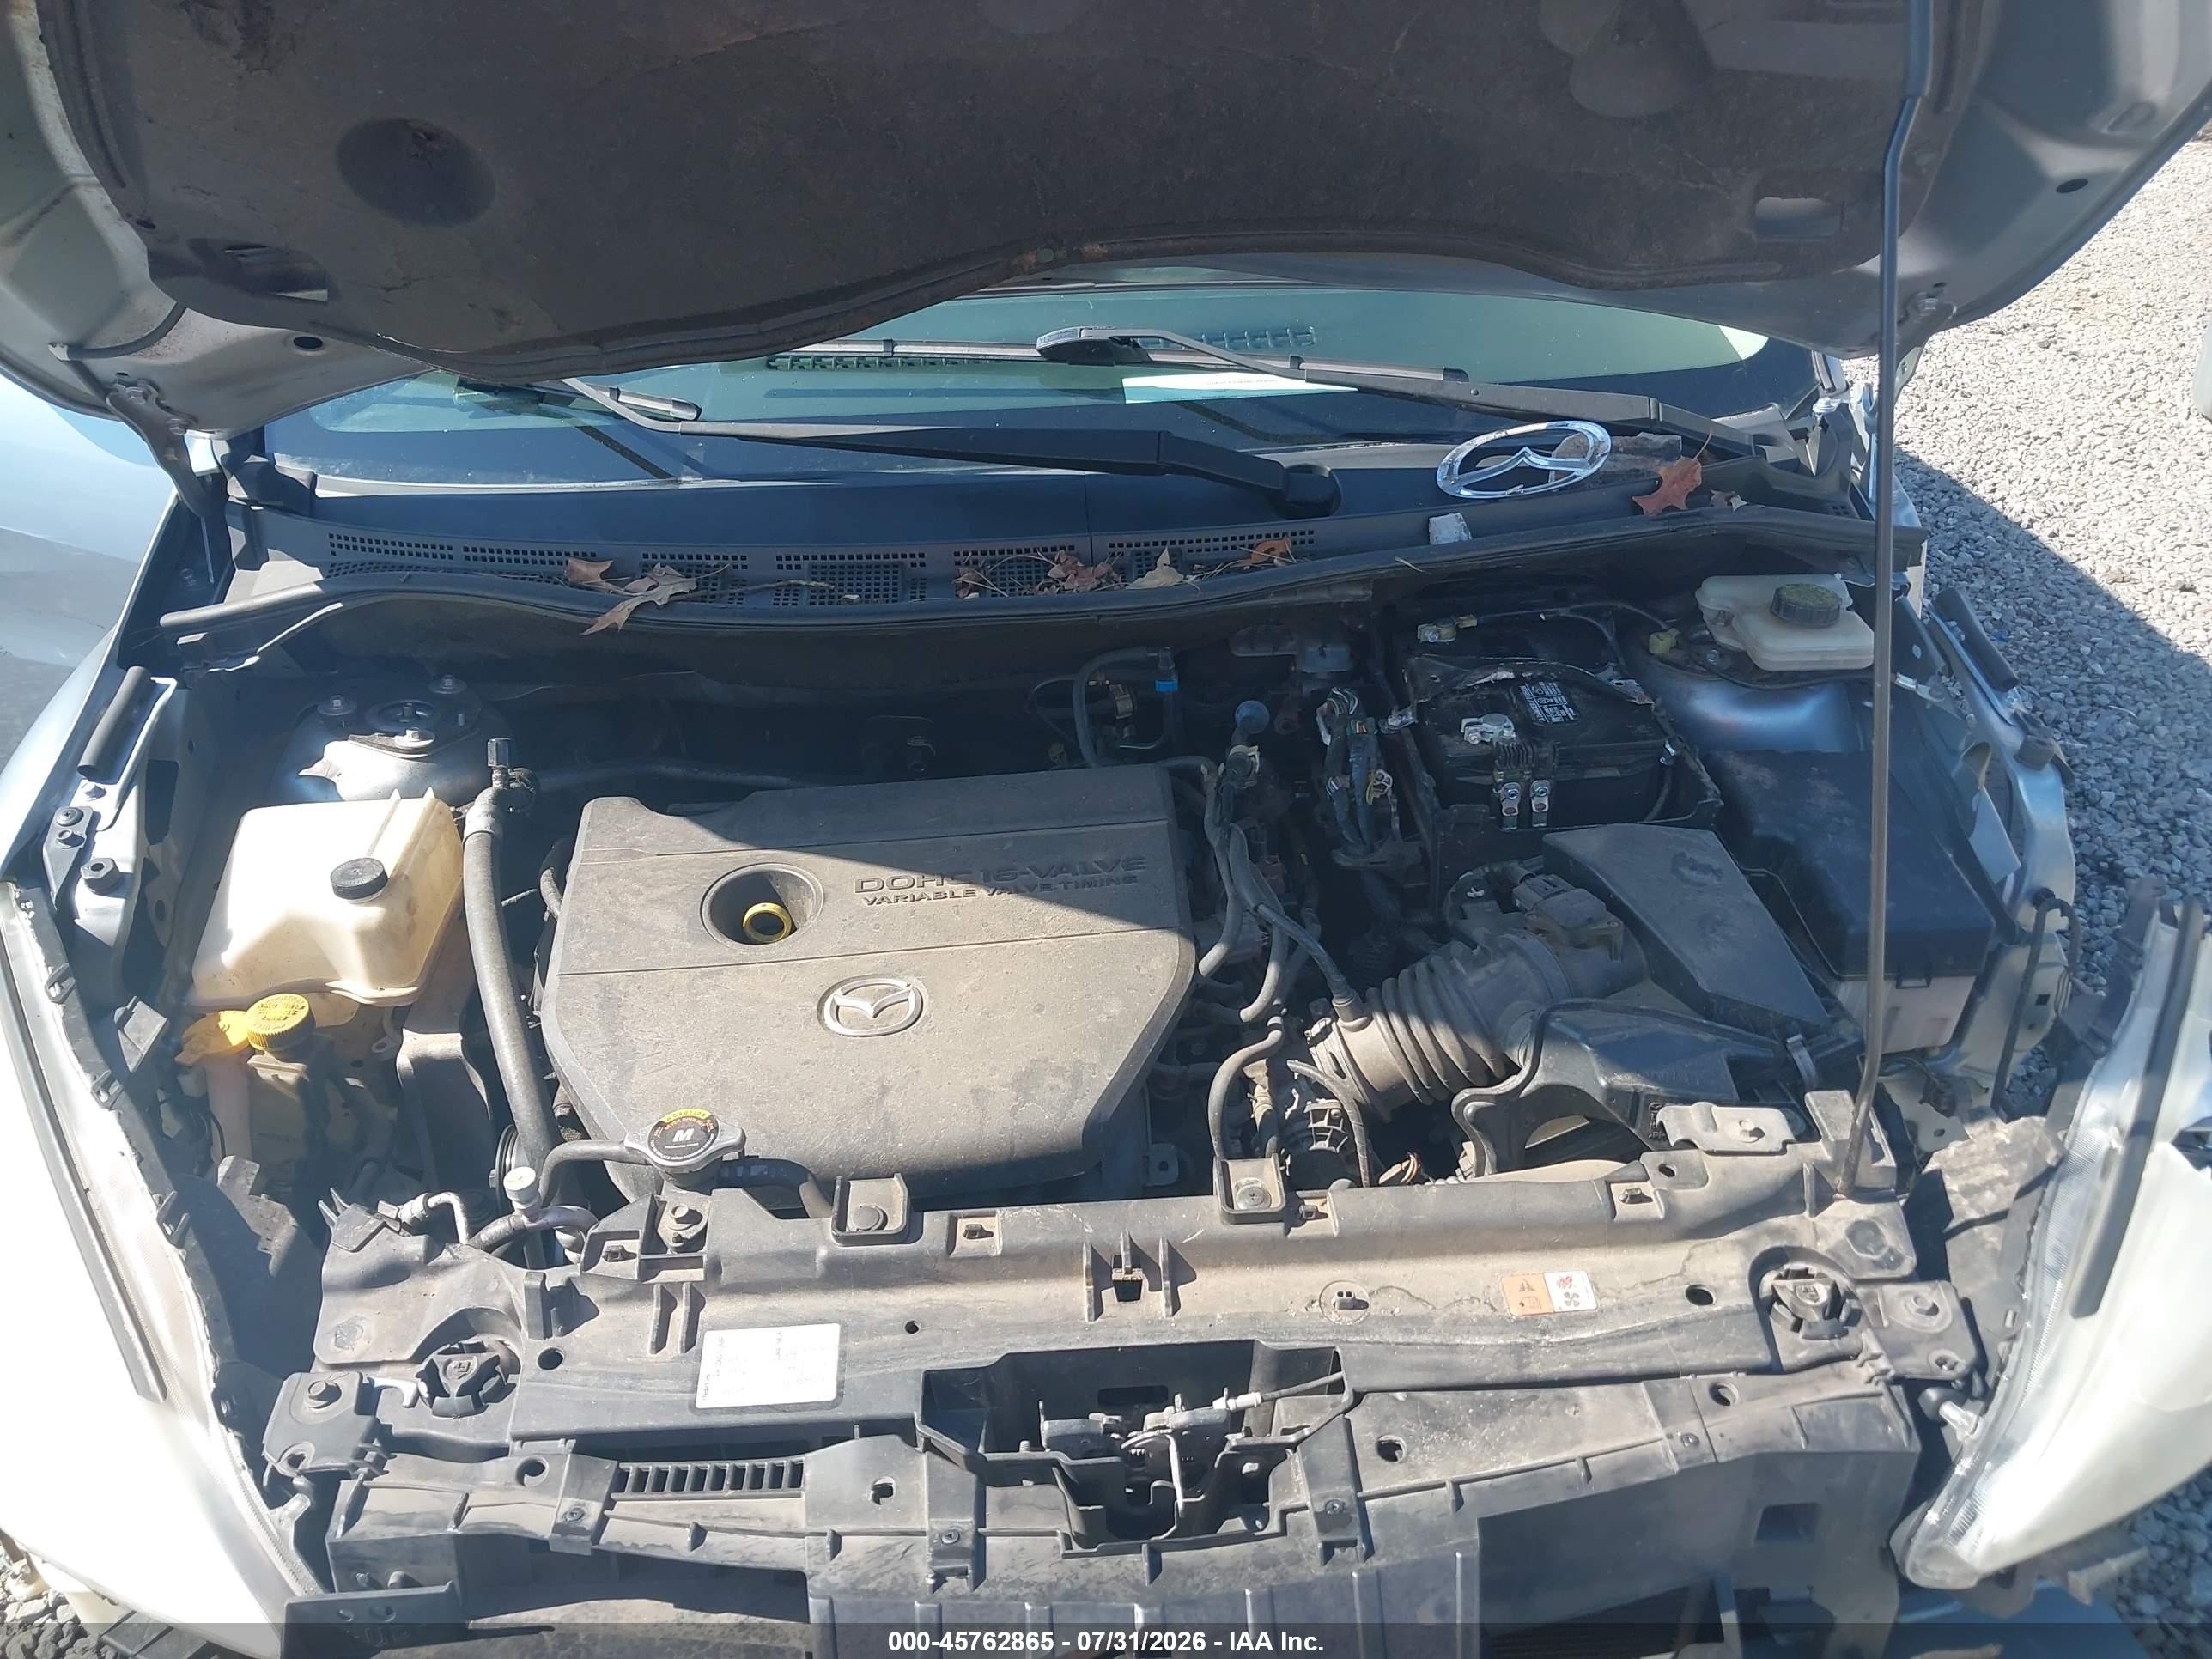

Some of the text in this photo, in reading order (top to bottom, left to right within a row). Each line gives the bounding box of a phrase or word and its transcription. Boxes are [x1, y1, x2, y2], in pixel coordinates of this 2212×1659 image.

[854, 857, 1147, 893] DOHC 16-VALVE
[864, 875, 1138, 906] VARIABLE VALVE TIMING
